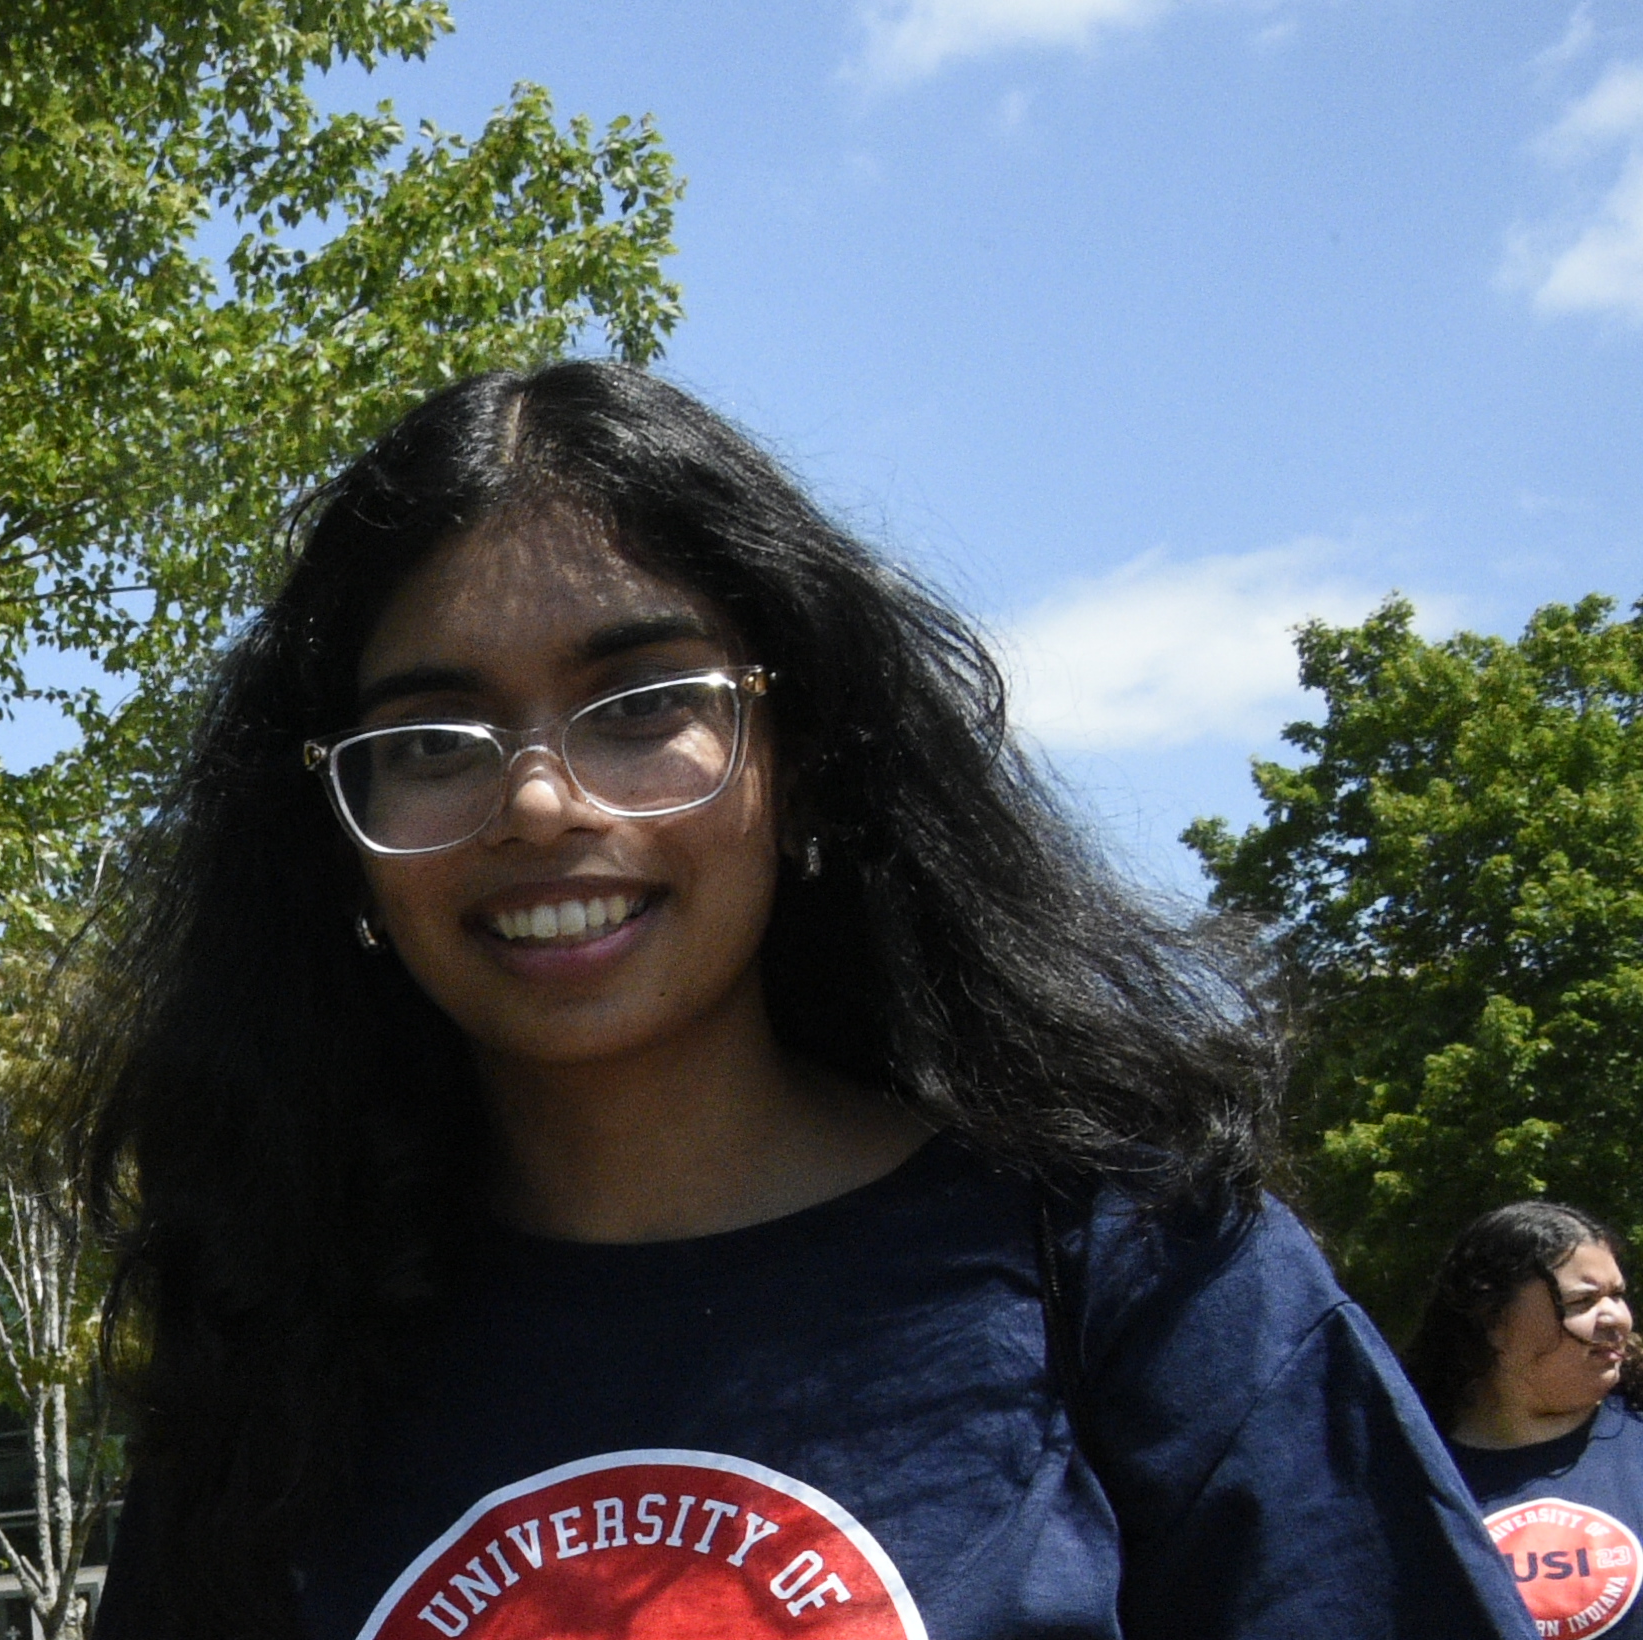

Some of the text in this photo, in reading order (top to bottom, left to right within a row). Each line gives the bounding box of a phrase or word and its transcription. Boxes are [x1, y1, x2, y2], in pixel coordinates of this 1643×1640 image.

[1584, 1521, 1611, 1537] OF
[417, 1493, 851, 1638] UNIVERSITY OF
[1505, 1545, 1632, 1583] USI 23
[1567, 1576, 1628, 1633] INDIANA
